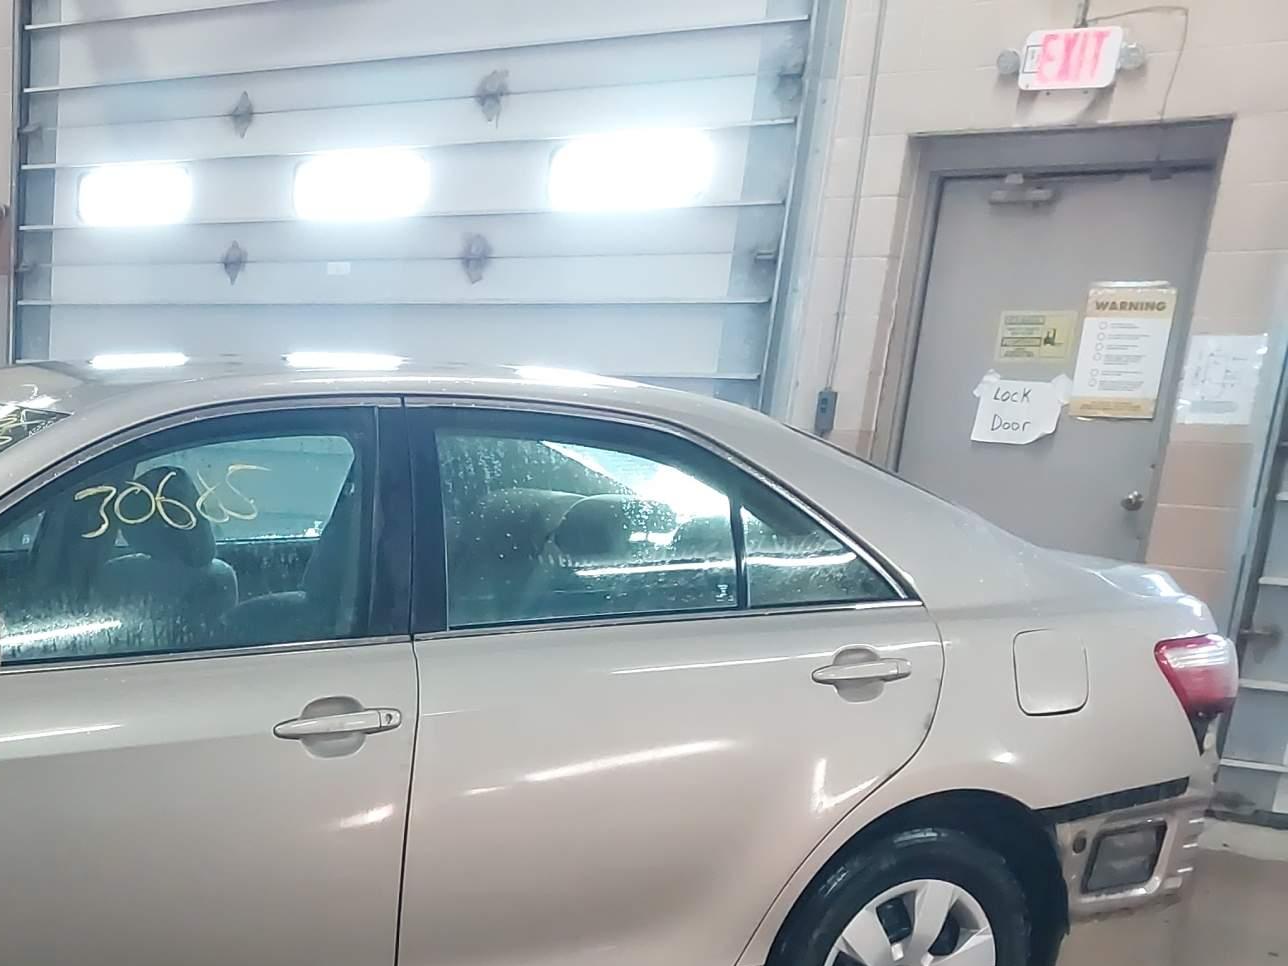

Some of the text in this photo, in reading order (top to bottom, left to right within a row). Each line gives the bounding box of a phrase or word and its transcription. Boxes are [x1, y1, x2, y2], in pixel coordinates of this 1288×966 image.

[1038, 31, 1111, 83] EXIT
[1095, 300, 1167, 312] WARNING
[991, 414, 1031, 431] Door
